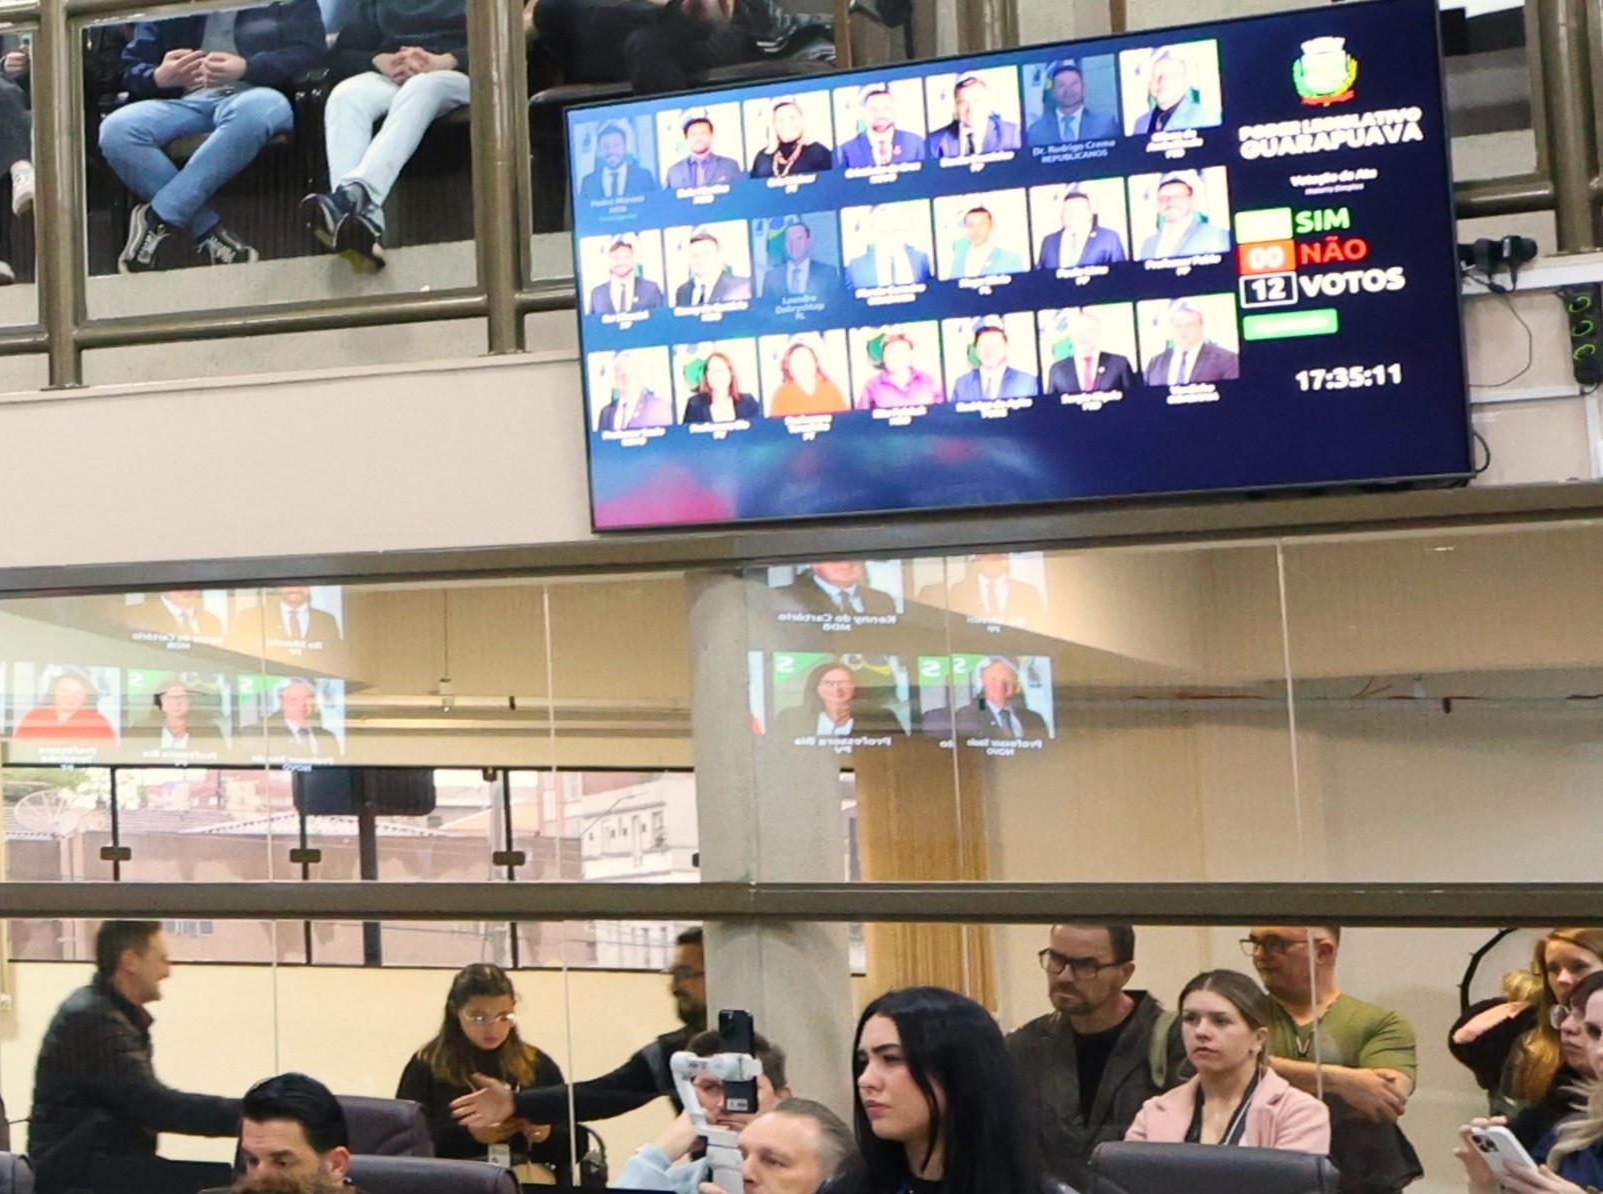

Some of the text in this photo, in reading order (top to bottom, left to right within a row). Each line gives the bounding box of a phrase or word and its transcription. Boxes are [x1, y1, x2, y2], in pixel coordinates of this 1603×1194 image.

[1238, 120, 1300, 141] PODER
[1240, 122, 1424, 160] GUARAPUAVA
[1295, 207, 1350, 234] SIM
[1248, 235, 1368, 271] 00 NÃO
[1251, 266, 1406, 301] 12 VOTOS
[1294, 362, 1402, 392] 17:35:11
